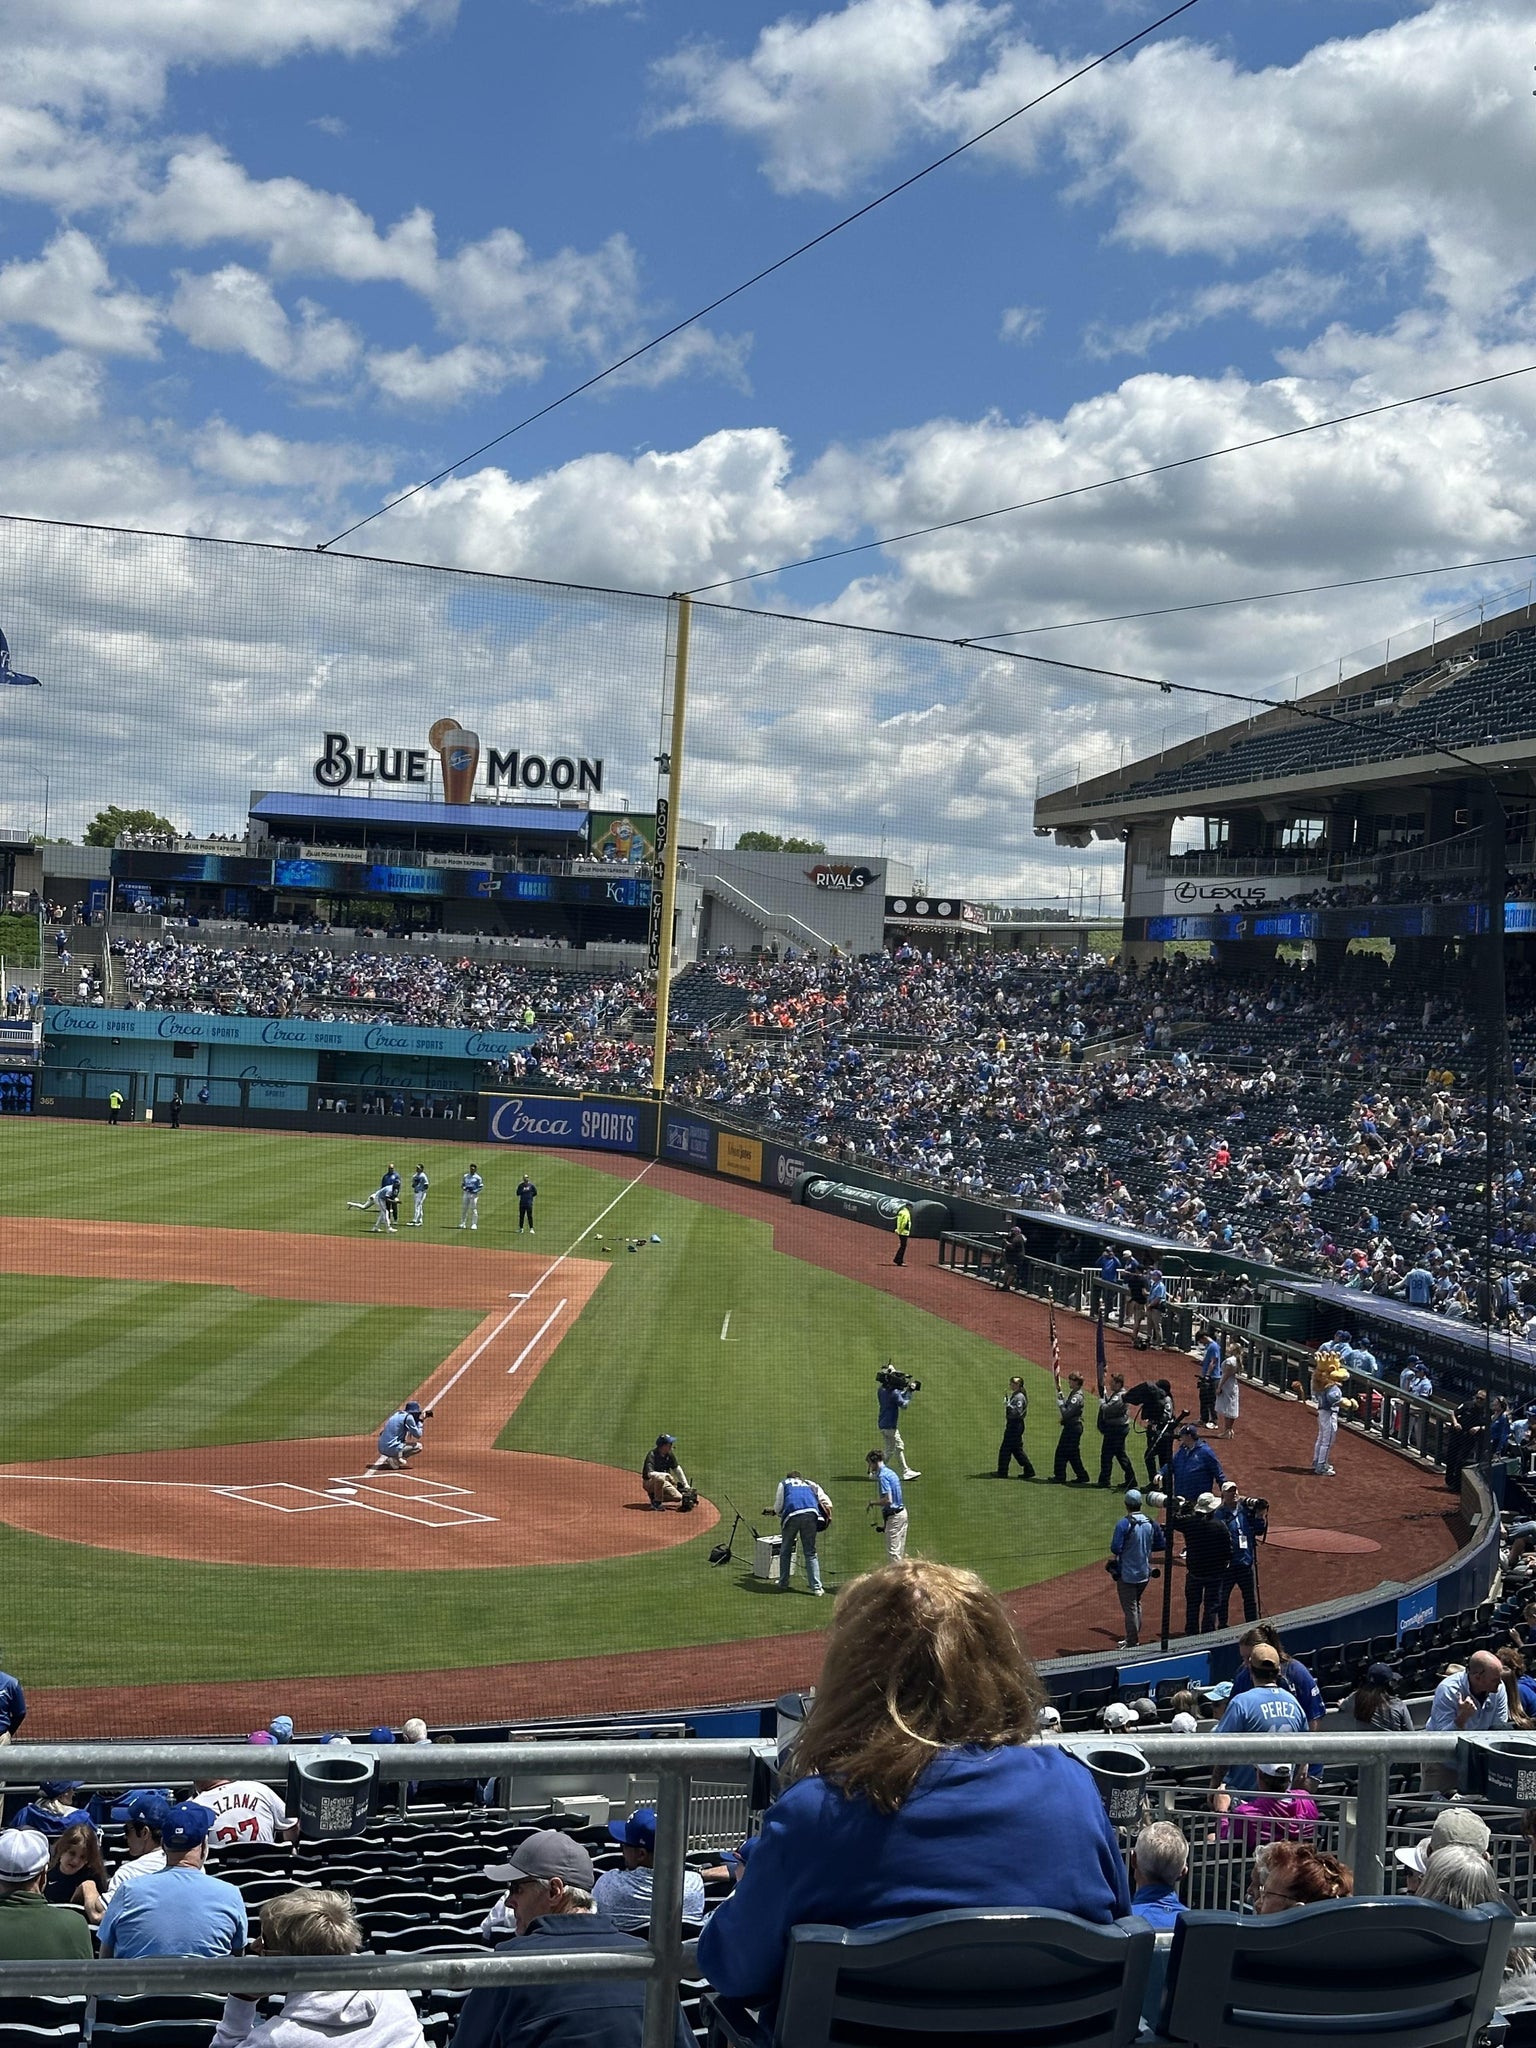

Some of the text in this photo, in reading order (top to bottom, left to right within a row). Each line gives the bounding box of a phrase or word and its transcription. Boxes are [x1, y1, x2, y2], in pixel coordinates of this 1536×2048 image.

[314, 731, 604, 794] BLUE MOON
[816, 873, 864, 888] RIVALS
[1199, 887, 1266, 900] LEXUS
[52, 1009, 135, 1032] Circa SPORTS
[158, 1015, 240, 1038] Circa SPORTS
[261, 1021, 342, 1044] Circa SPORTS
[364, 1028, 444, 1050] Circa SPORTS
[465, 1034, 509, 1056] Circa
[492, 1099, 634, 1143] Circa SPORTS
[1260, 1701, 1297, 1720] PEREZ
[213, 1793, 259, 1817] ZZANA
